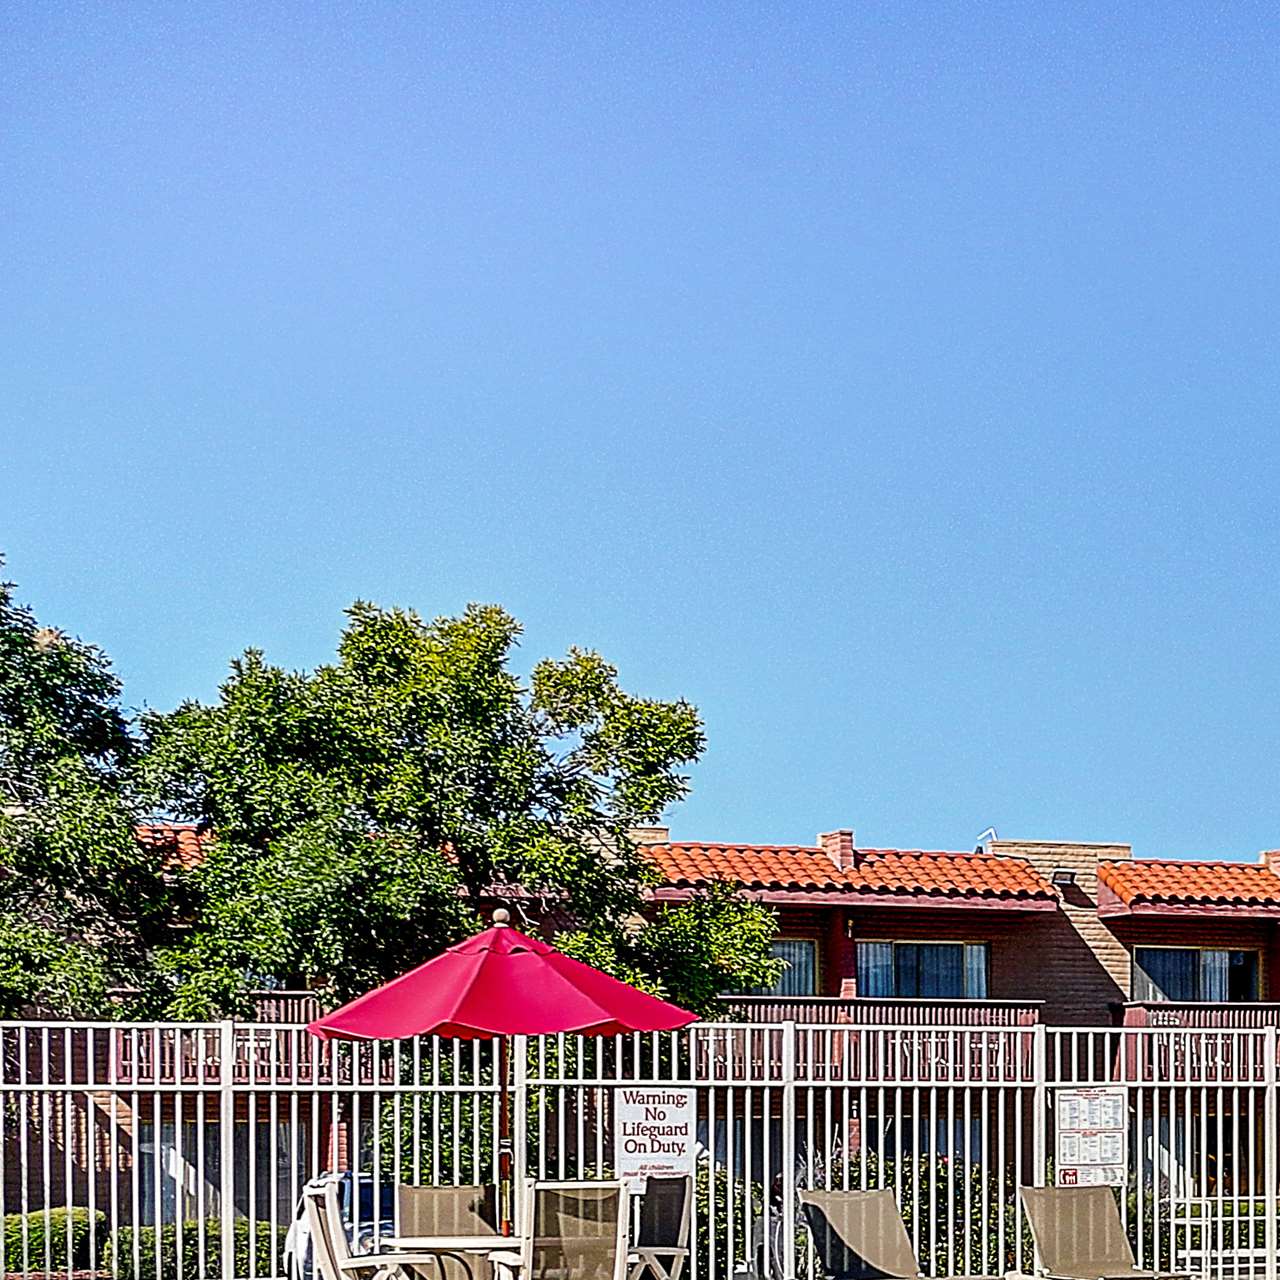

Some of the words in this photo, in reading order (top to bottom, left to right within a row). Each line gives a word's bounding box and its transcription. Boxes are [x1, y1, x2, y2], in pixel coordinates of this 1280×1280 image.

[623, 1090, 688, 1108] Warning:
[645, 1107, 666, 1121] No
[623, 1122, 688, 1140] Lifeguard
[624, 1138, 647, 1153] On
[651, 1139, 686, 1156] Duty.
